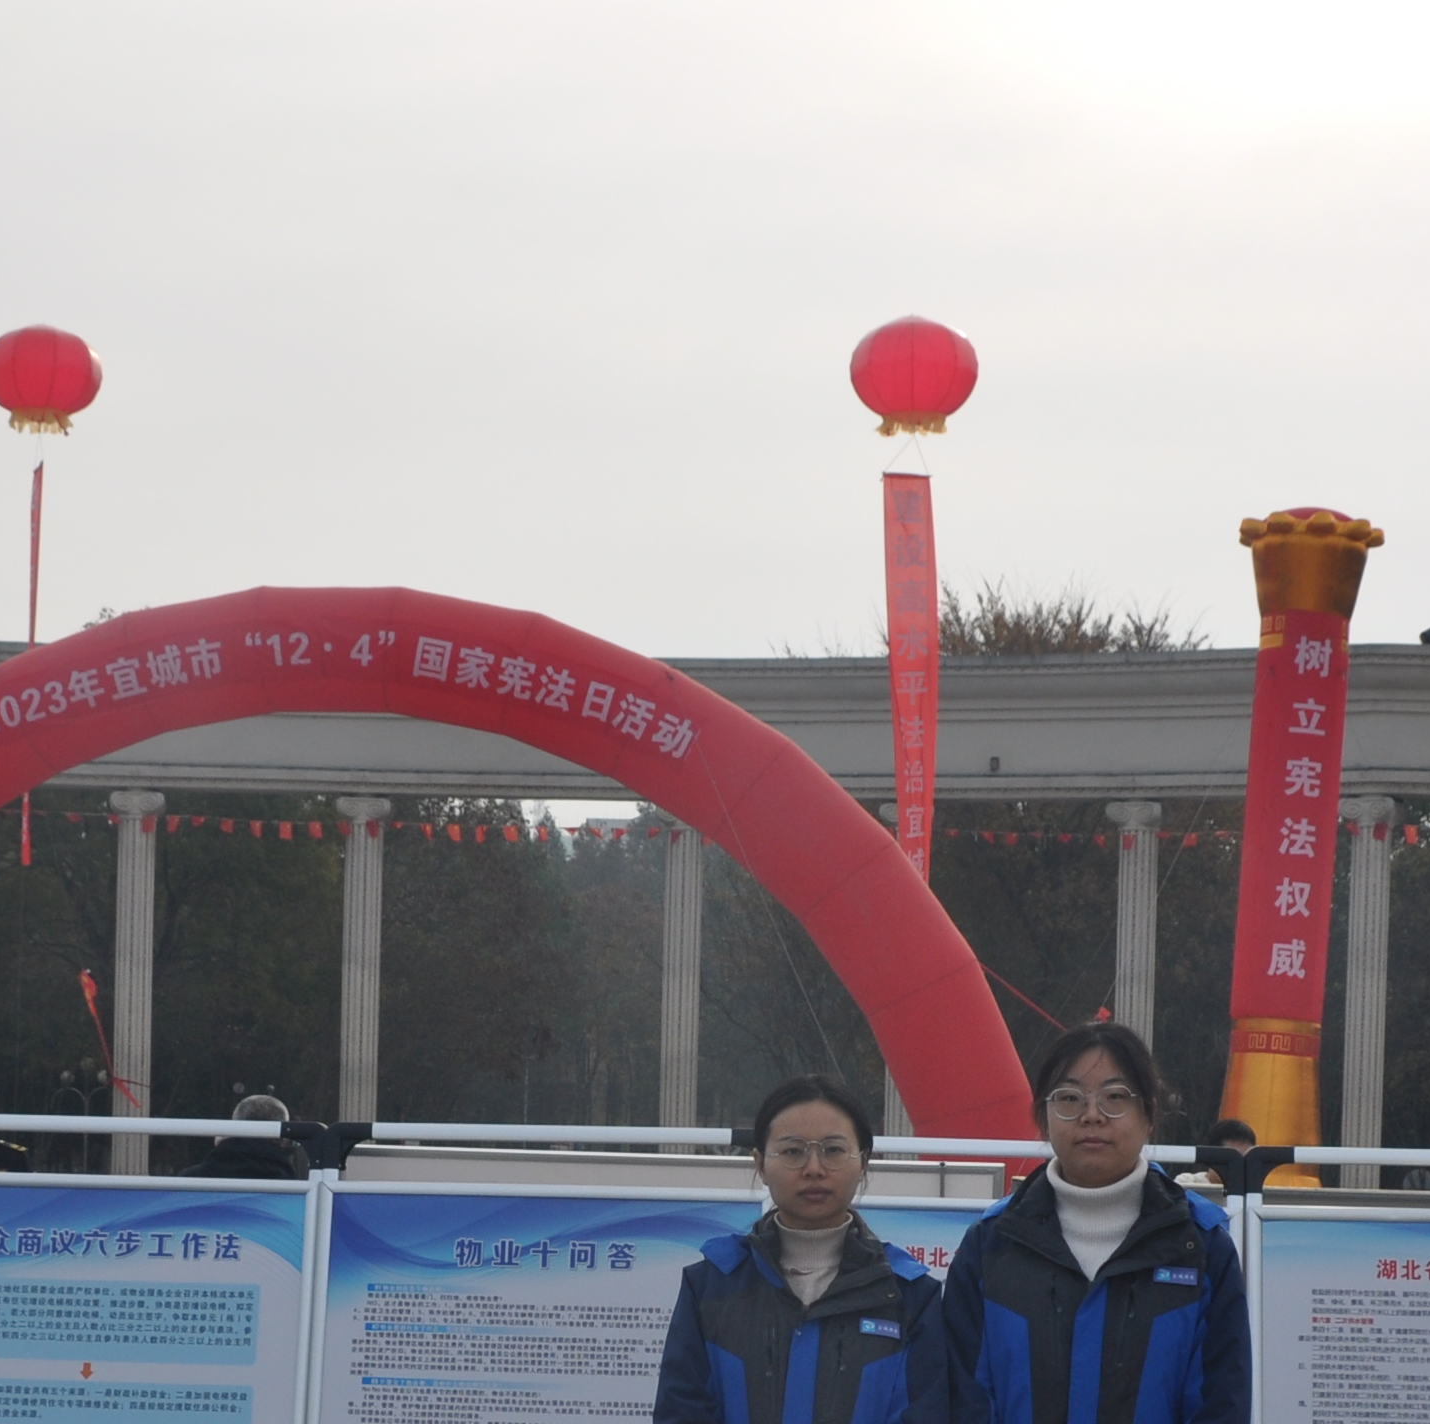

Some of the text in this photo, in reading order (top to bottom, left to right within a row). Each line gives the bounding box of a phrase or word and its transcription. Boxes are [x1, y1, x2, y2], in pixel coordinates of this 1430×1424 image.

[1267, 635, 1333, 980] 树立宪法权威
[454, 1237, 637, 1271] 物业十问答
[906, 1246, 962, 1268] 湖北
